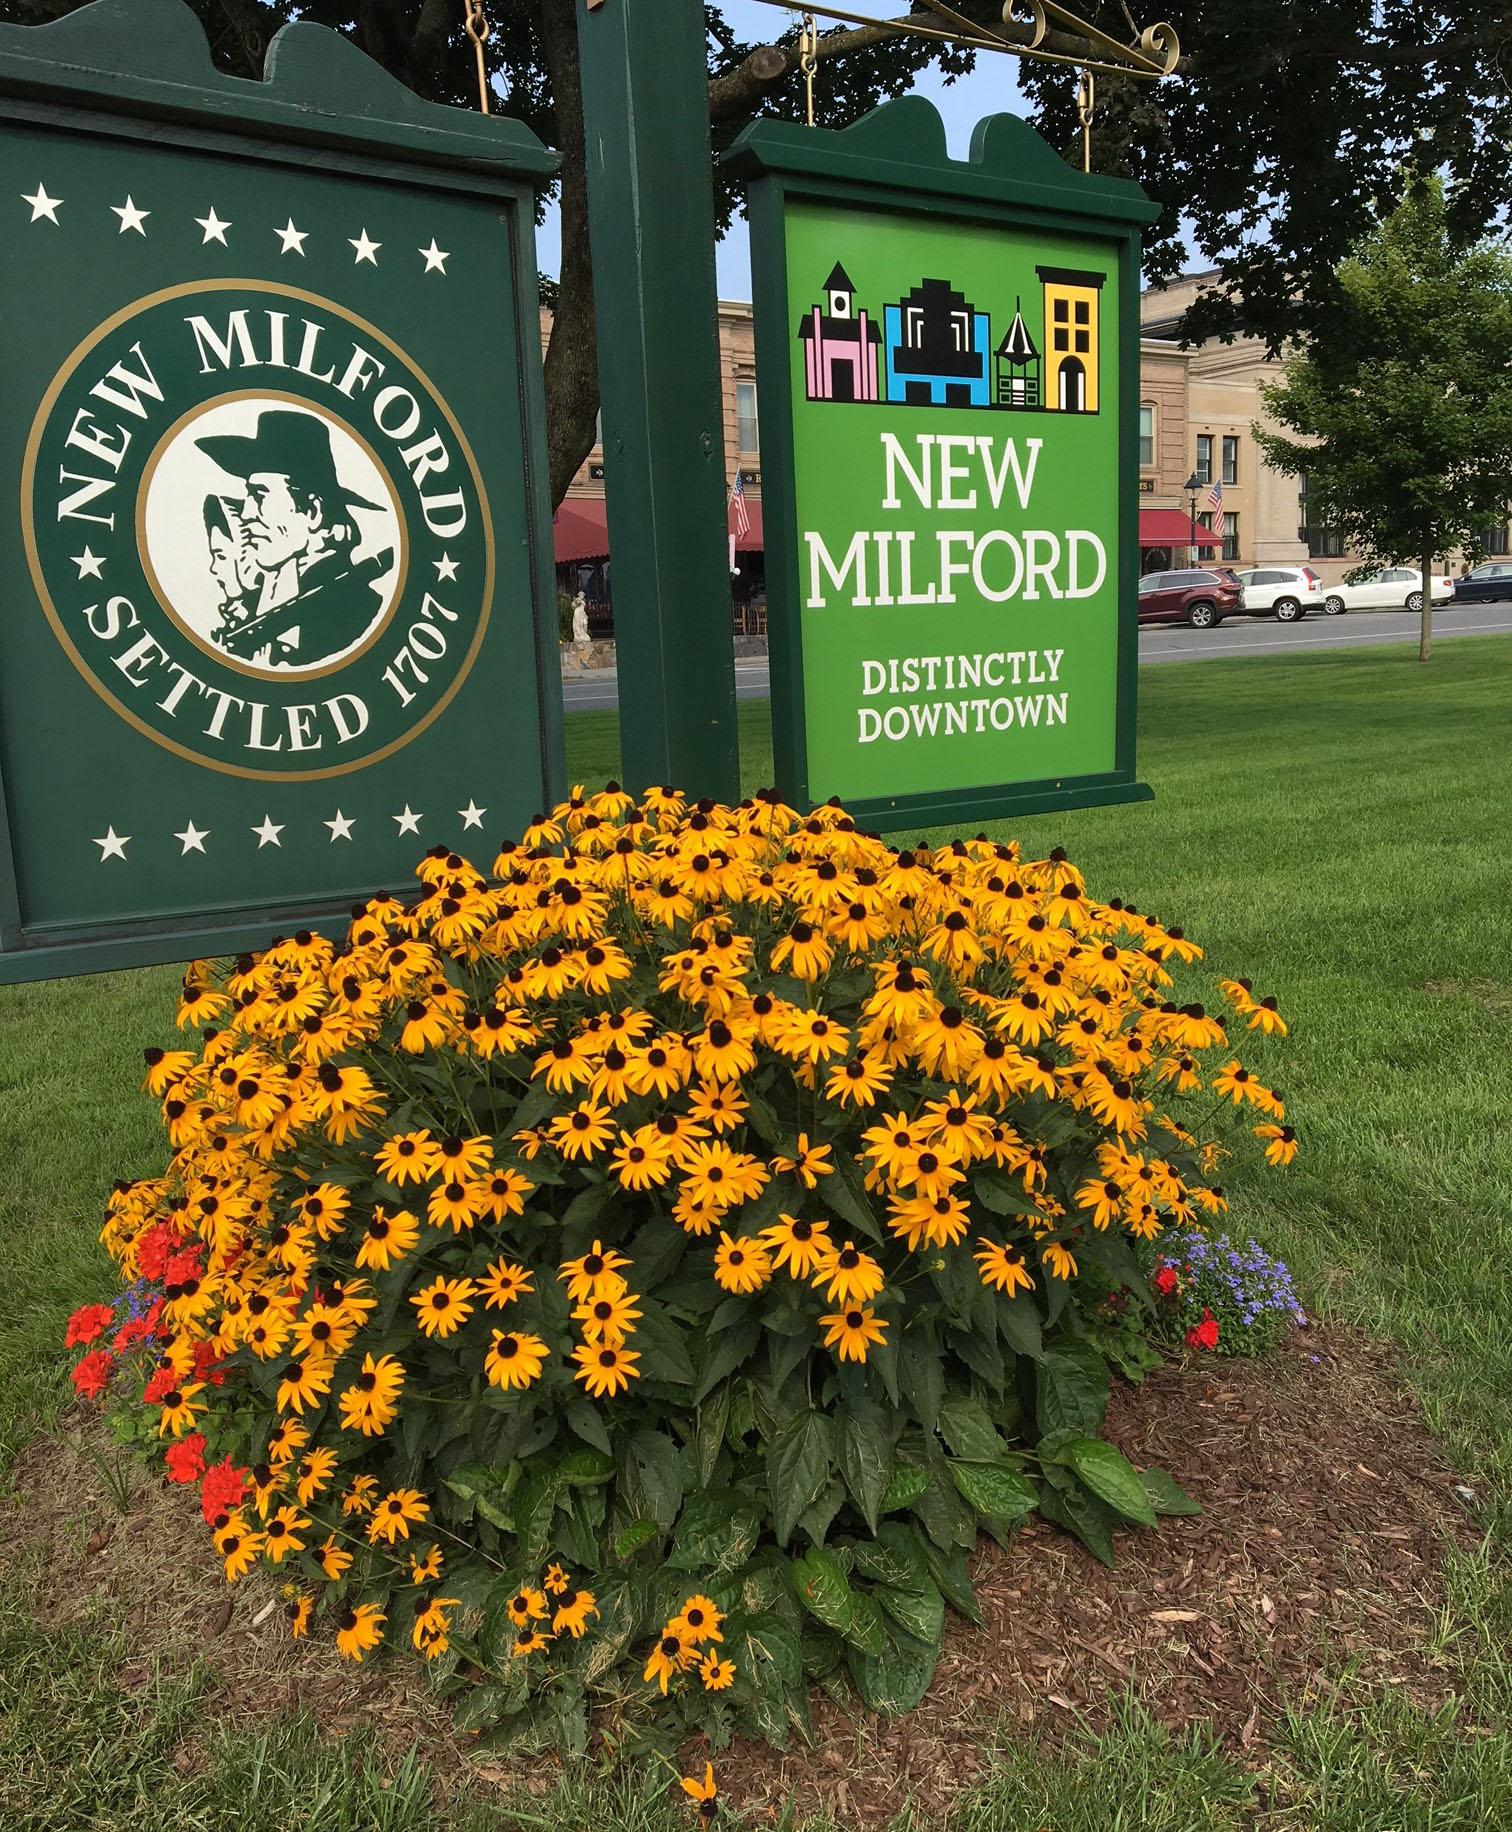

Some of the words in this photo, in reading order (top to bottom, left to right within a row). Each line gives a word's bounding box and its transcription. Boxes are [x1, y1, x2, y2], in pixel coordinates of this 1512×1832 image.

[57, 340, 165, 532] NEW
[183, 309, 467, 538] MILFORD
[880, 432, 1044, 510] NEW
[804, 529, 1107, 608] MILFORD
[82, 595, 369, 752] SETTLED
[381, 592, 459, 708] 1707
[862, 649, 1065, 696] DISTINCTLY
[857, 692, 1069, 743] DOWNTOWN
